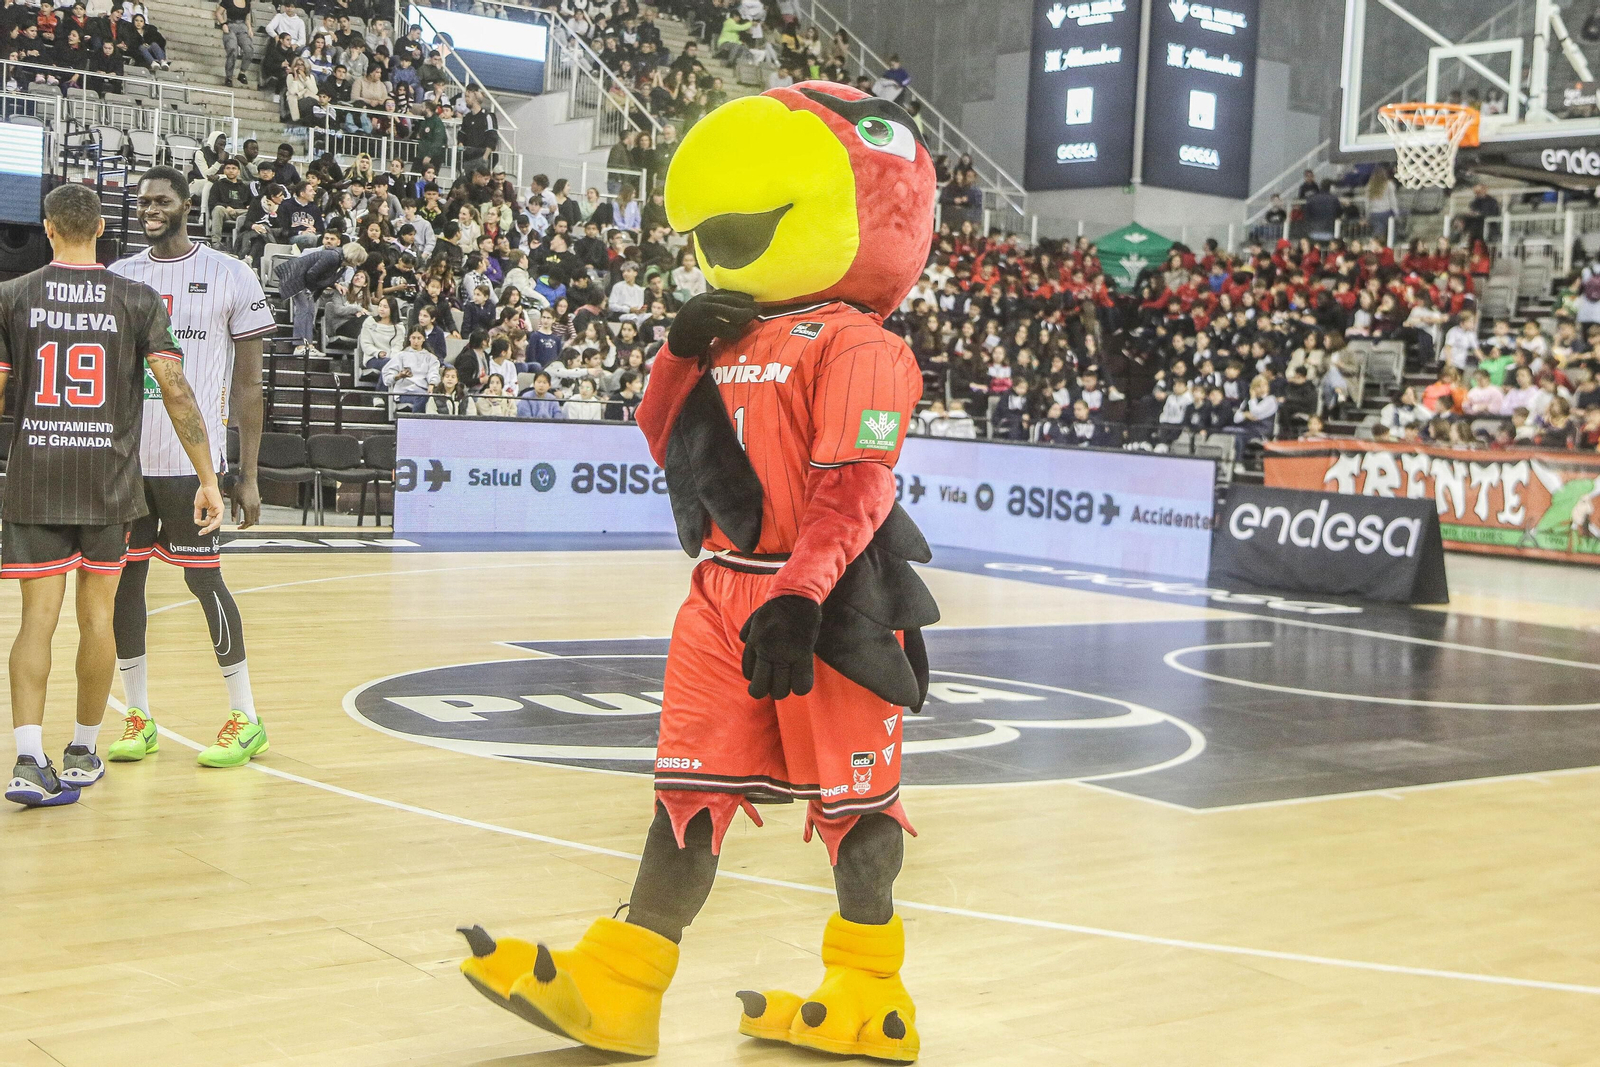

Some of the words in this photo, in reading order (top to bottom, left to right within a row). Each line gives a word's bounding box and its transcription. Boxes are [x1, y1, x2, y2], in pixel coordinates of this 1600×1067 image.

[1541, 147, 1600, 176] ende
[46, 280, 107, 303] TOMÀS
[30, 307, 118, 333] PULEVA
[174, 326, 207, 341] mbra
[34, 341, 106, 408] 19
[711, 354, 793, 386] OVIRAN
[22, 417, 114, 434] AYUNTAMIENTO
[734, 406, 746, 451] 1
[28, 434, 46, 446] DE
[49, 434, 113, 448] GRANADA
[468, 468, 522, 487] Salud
[939, 484, 967, 504] Vida
[1008, 485, 1094, 524] asisa
[1229, 499, 1422, 558] endesa
[176, 545, 211, 553] BERNER
[656, 757, 691, 770] asisa
[853, 757, 871, 766] acb
[820, 784, 849, 798] RNER
